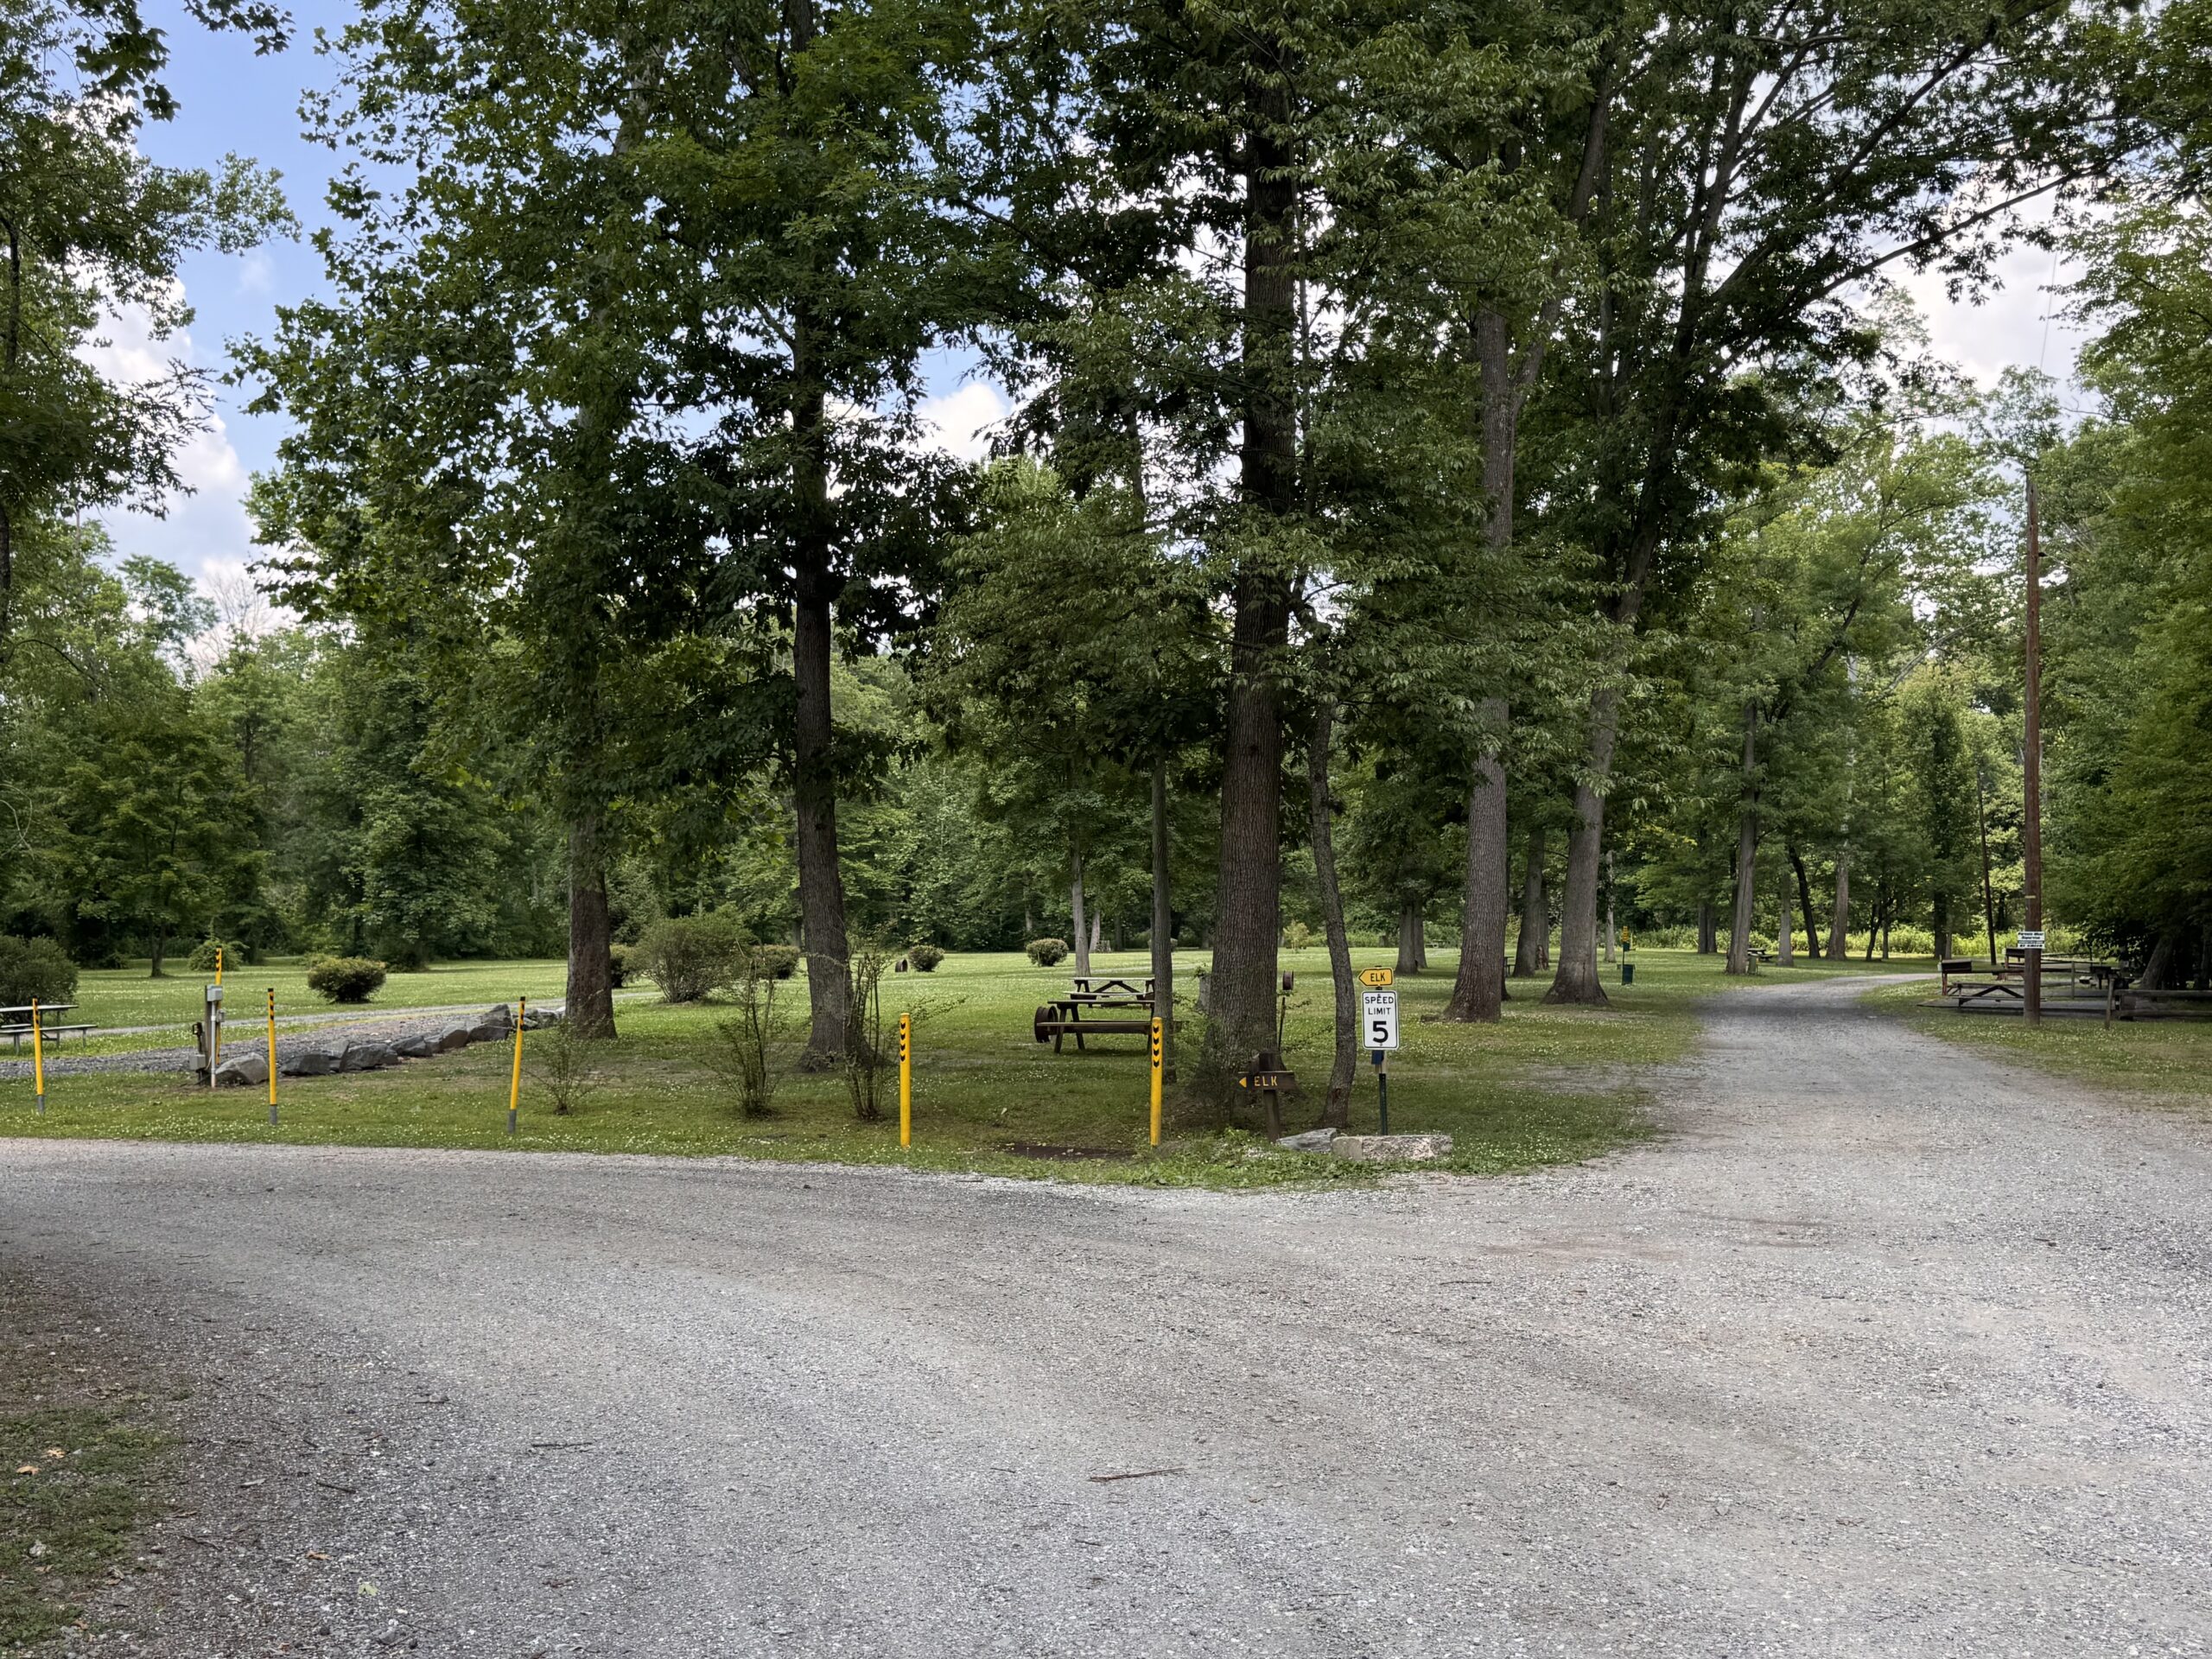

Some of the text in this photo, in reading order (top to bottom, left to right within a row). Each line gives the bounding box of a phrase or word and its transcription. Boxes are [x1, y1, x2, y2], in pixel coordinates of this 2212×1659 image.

[1370, 973, 1385, 982] ELK
[1373, 1020, 1389, 1043] 5
[1254, 1076, 1278, 1086] ELK
